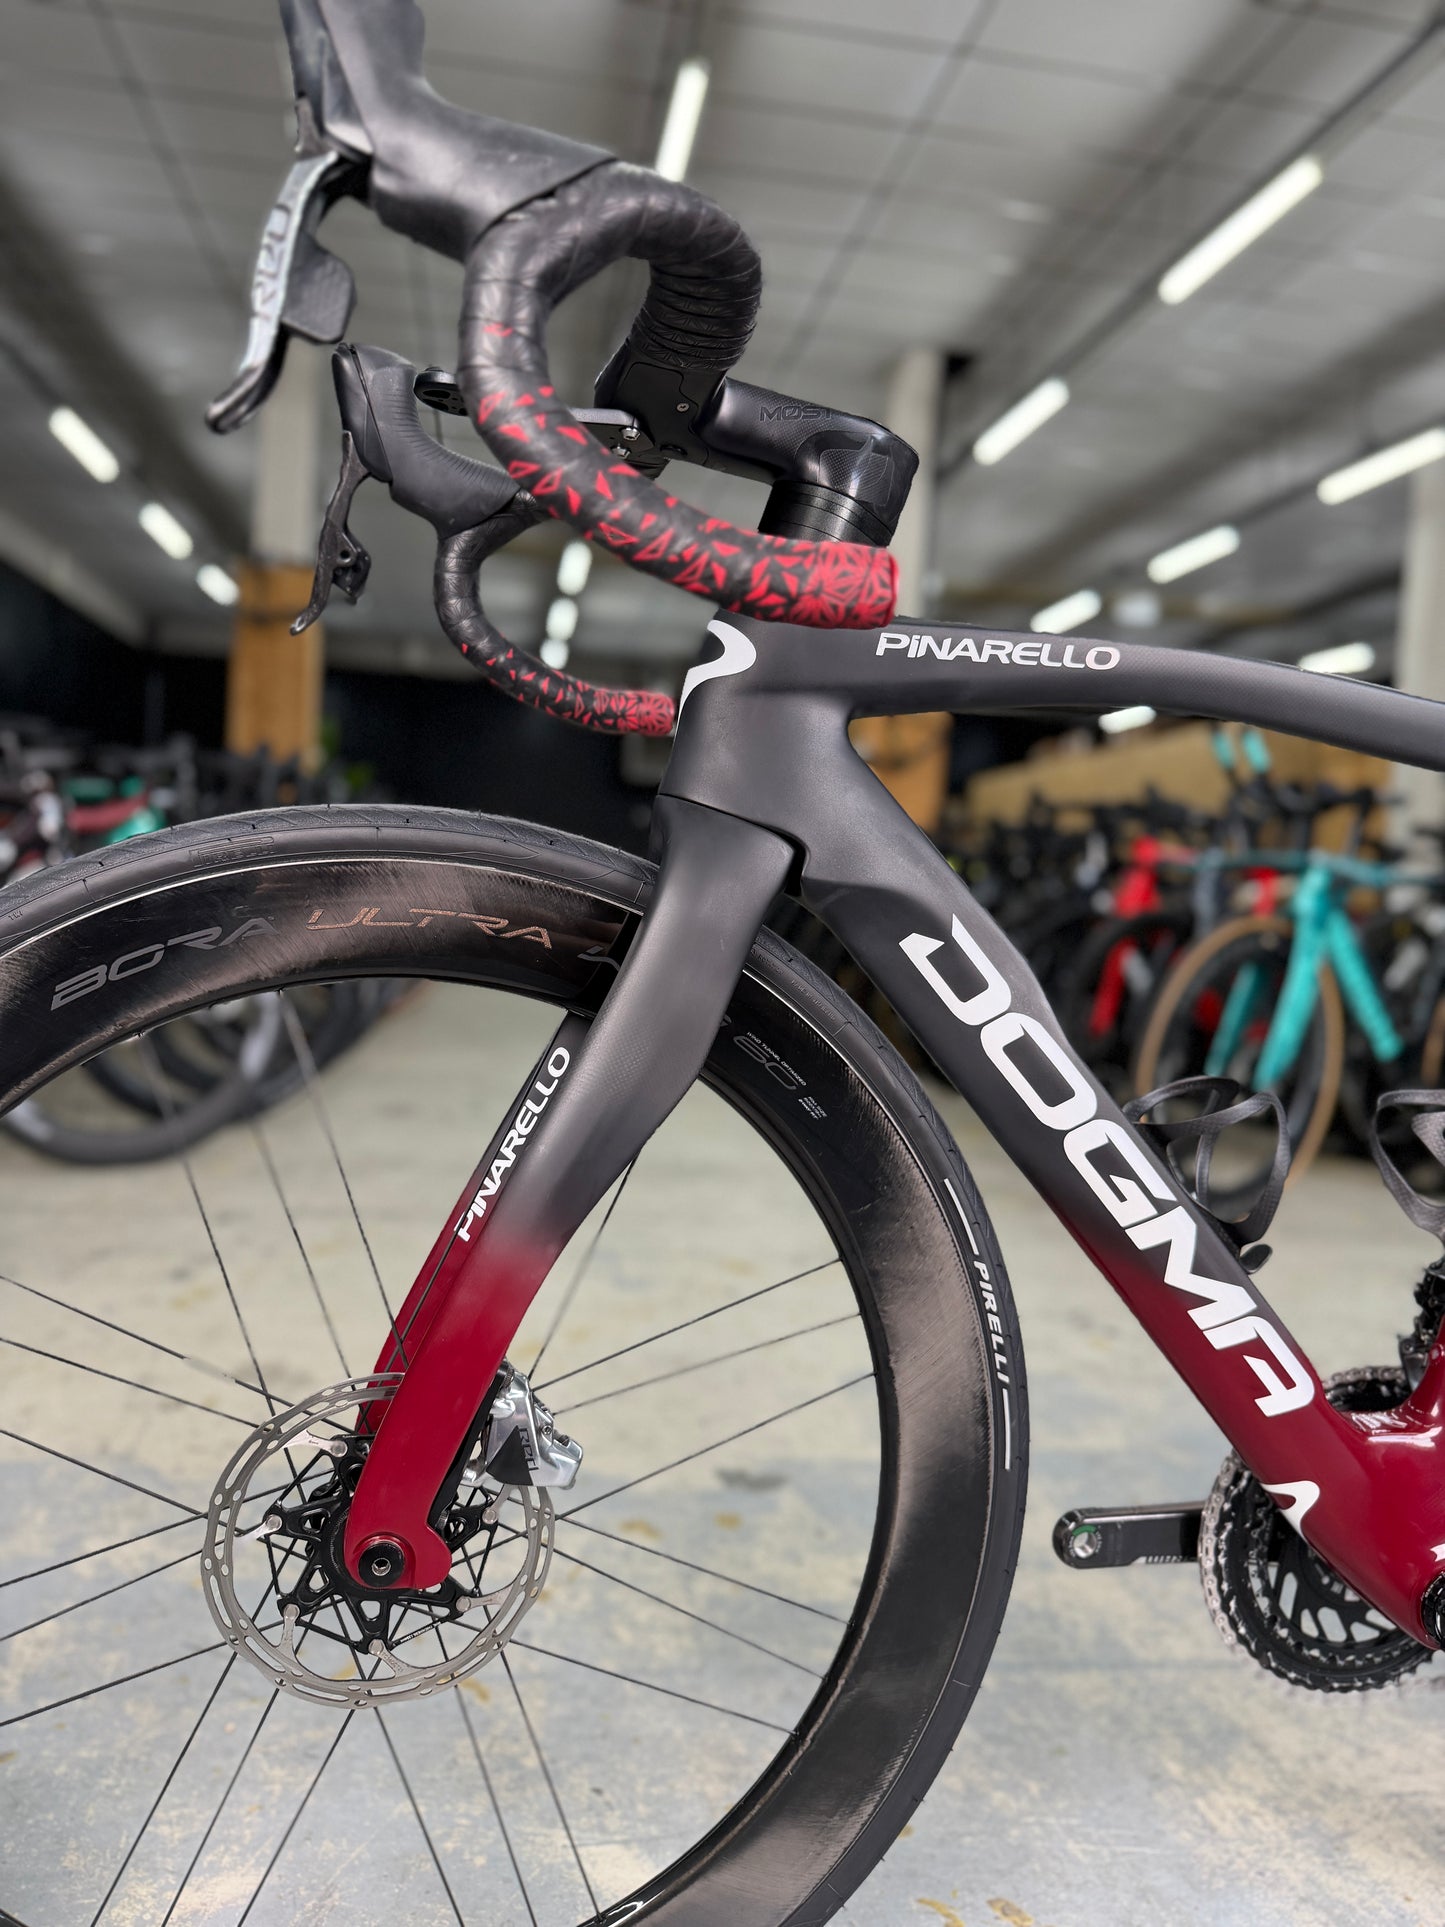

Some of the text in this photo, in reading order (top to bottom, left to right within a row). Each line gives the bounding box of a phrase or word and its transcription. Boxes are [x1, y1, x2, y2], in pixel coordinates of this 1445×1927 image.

[51, 907, 552, 1011] BORA ULTRA
[454, 1046, 571, 1242] PINARELLO
[899, 913, 1315, 1417] DOGMA
[973, 1260, 1010, 1384] PIRELLI
